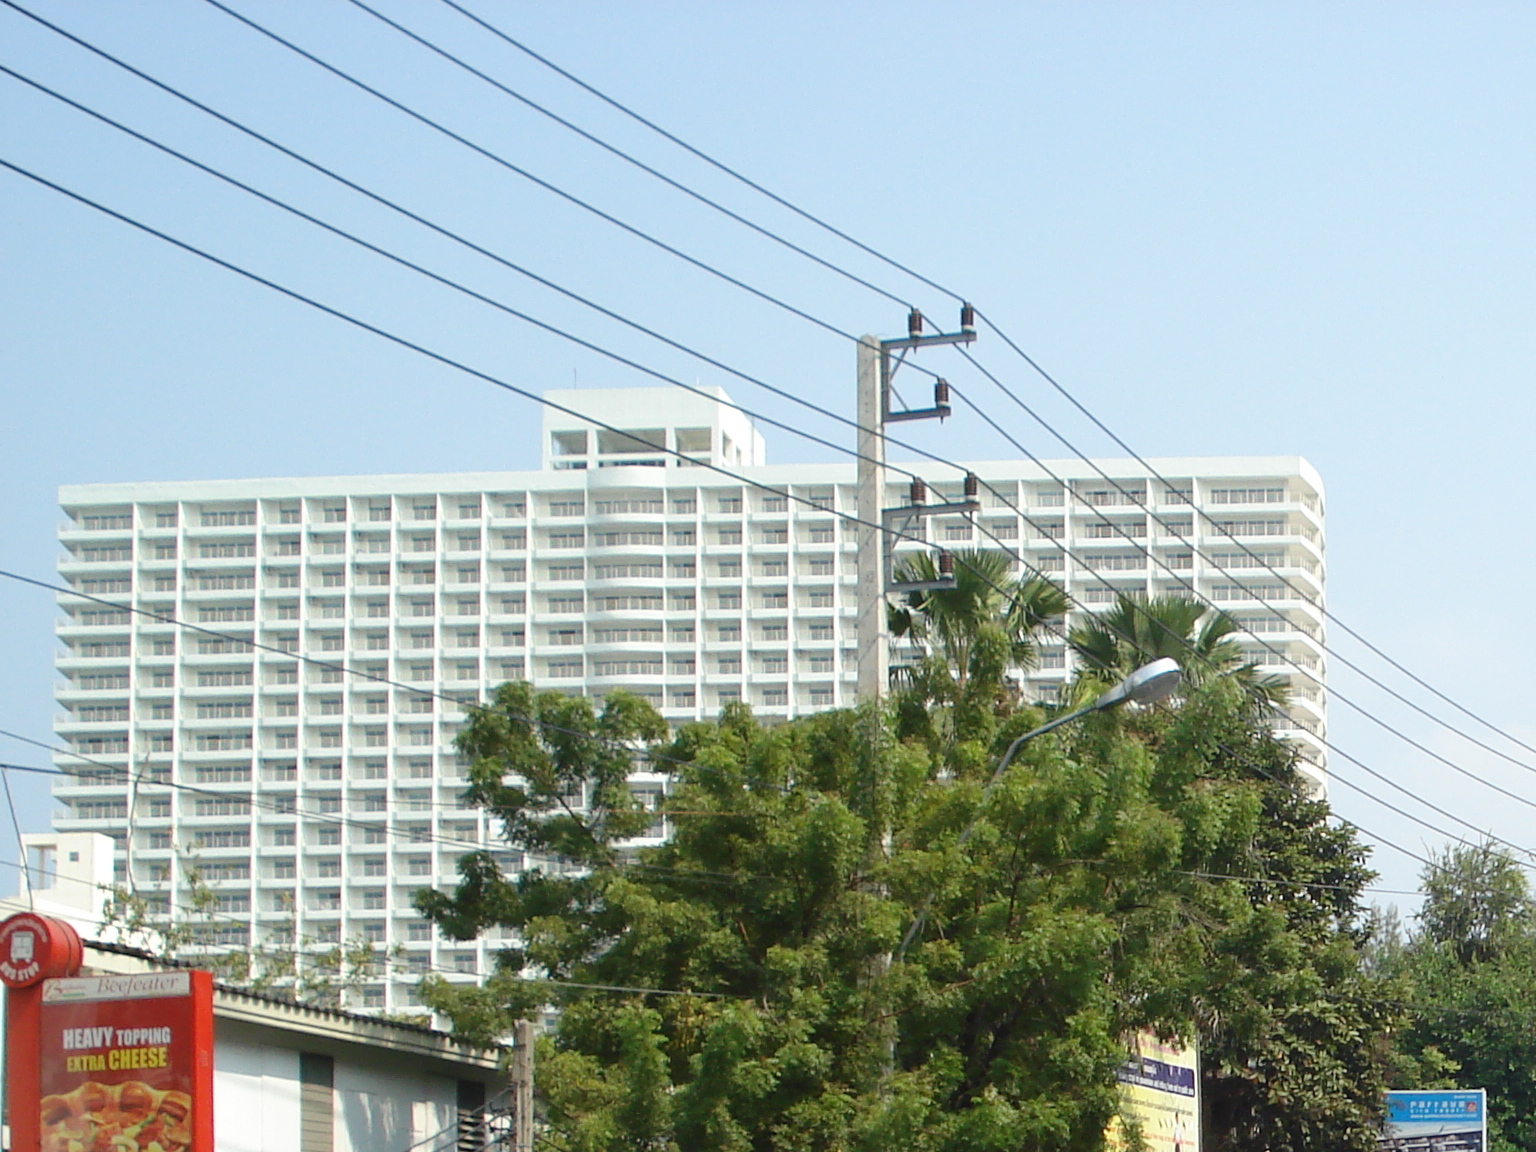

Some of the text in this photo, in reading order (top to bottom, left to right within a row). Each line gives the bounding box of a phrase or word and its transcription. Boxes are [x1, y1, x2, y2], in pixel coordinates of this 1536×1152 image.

[17, 961, 40, 982] STOP
[63, 1026, 172, 1050] HEAVY TOPPING
[66, 1047, 168, 1073] EXTRA CHEESE
